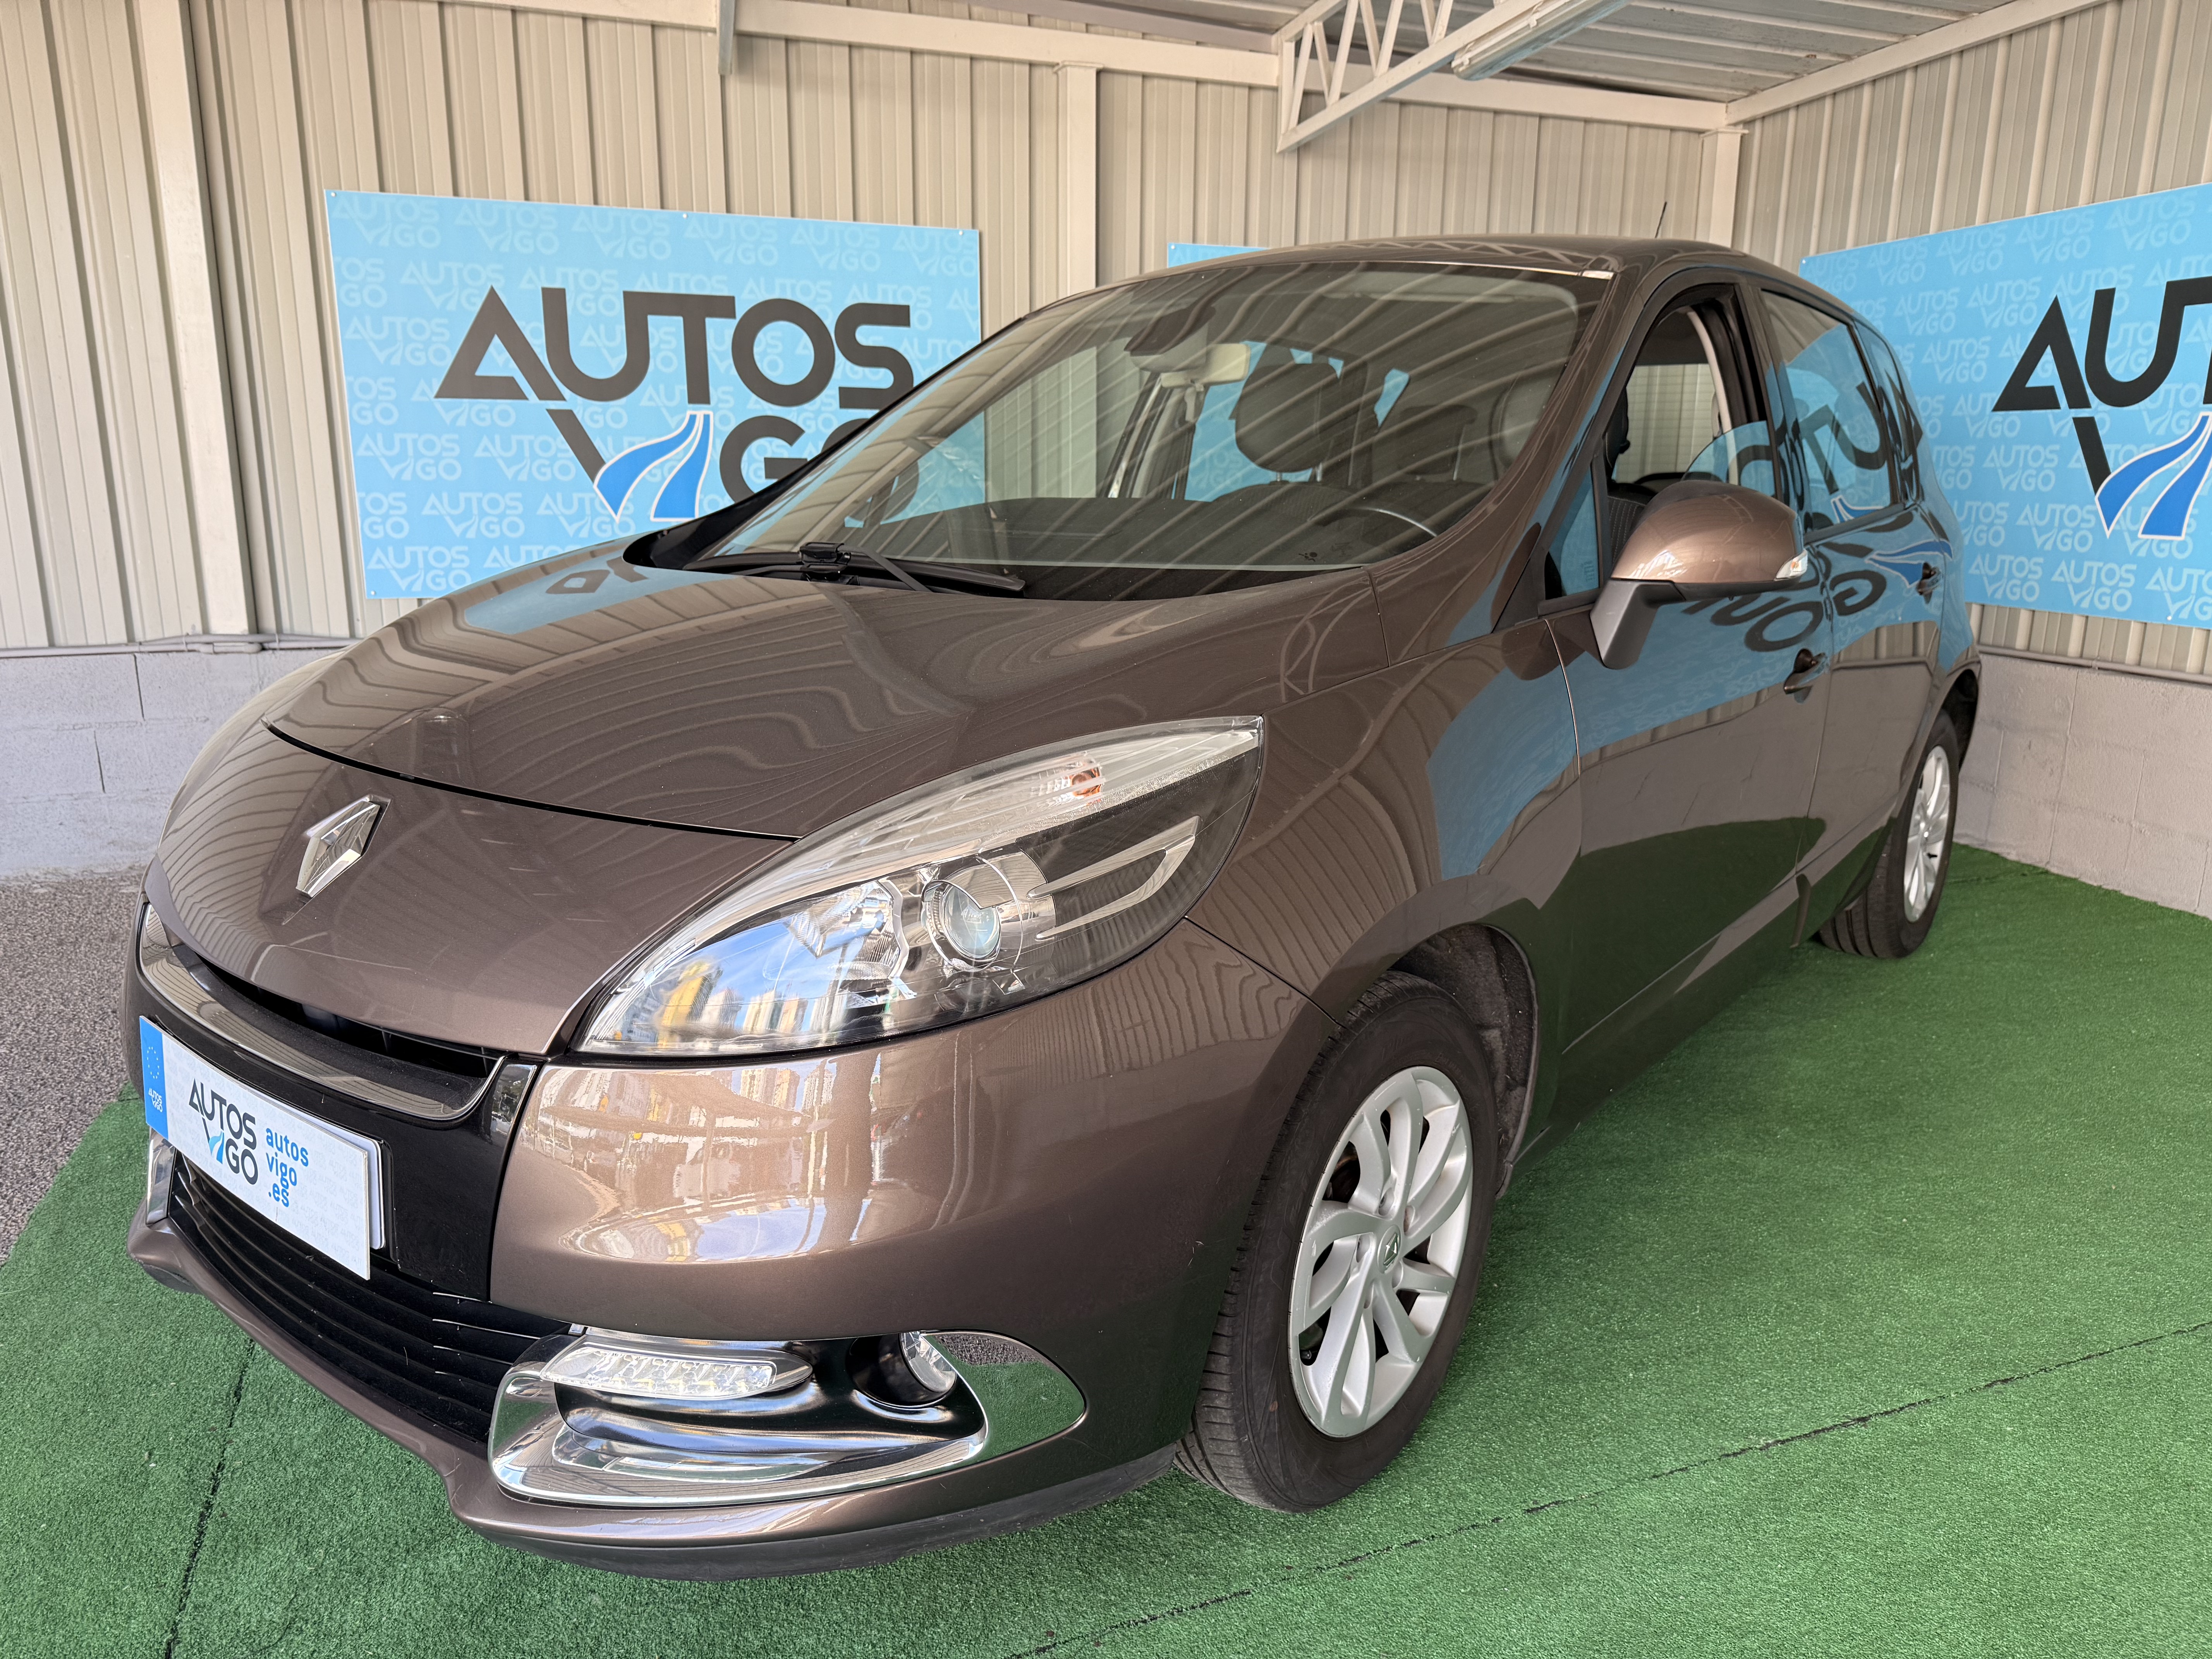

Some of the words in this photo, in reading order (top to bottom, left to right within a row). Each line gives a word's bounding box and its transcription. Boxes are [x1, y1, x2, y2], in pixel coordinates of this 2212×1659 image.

[331, 196, 439, 224] AUTOS
[453, 202, 558, 232] AUTOS
[571, 210, 671, 237] AUTOS
[2105, 191, 2197, 229] AUTOS
[682, 217, 784, 242] AUTOS
[790, 224, 880, 249] AUTOS
[1936, 224, 2008, 257] AUTOS
[2014, 210, 2095, 244] AUTOS
[892, 231, 978, 255] AUTOS
[1867, 237, 1929, 268] AUTOS
[400, 260, 505, 288] AUTOS
[519, 266, 620, 292] AUTOS
[634, 272, 728, 295] AUTOS
[2049, 264, 2135, 299] AUTOS
[741, 277, 833, 304] AUTOS
[845, 283, 931, 309] AUTOS
[1894, 287, 1960, 317] AUTOS
[1967, 276, 2042, 308] AUTOS
[345, 315, 450, 342] AUTOS
[434, 285, 914, 409] AUTOS
[1921, 336, 1991, 363] AUTOS
[356, 431, 460, 457] AUTOS
[473, 433, 573, 458] AUTOS
[1982, 444, 2060, 468] AUTOS
[421, 492, 523, 516] AUTOS
[2016, 503, 2096, 529] AUTOS
[367, 545, 471, 569] AUTOS
[1968, 554, 2044, 579] AUTOS
[2051, 560, 2137, 587] AUTOS
[148, 1087, 162, 1104] AUTOS
[189, 1078, 257, 1151] AUTOS
[202, 1117, 258, 1185] VIGO
[266, 1128, 309, 1167] autos
[266, 1153, 297, 1190] vigo
[268, 1182, 289, 1207] .es
